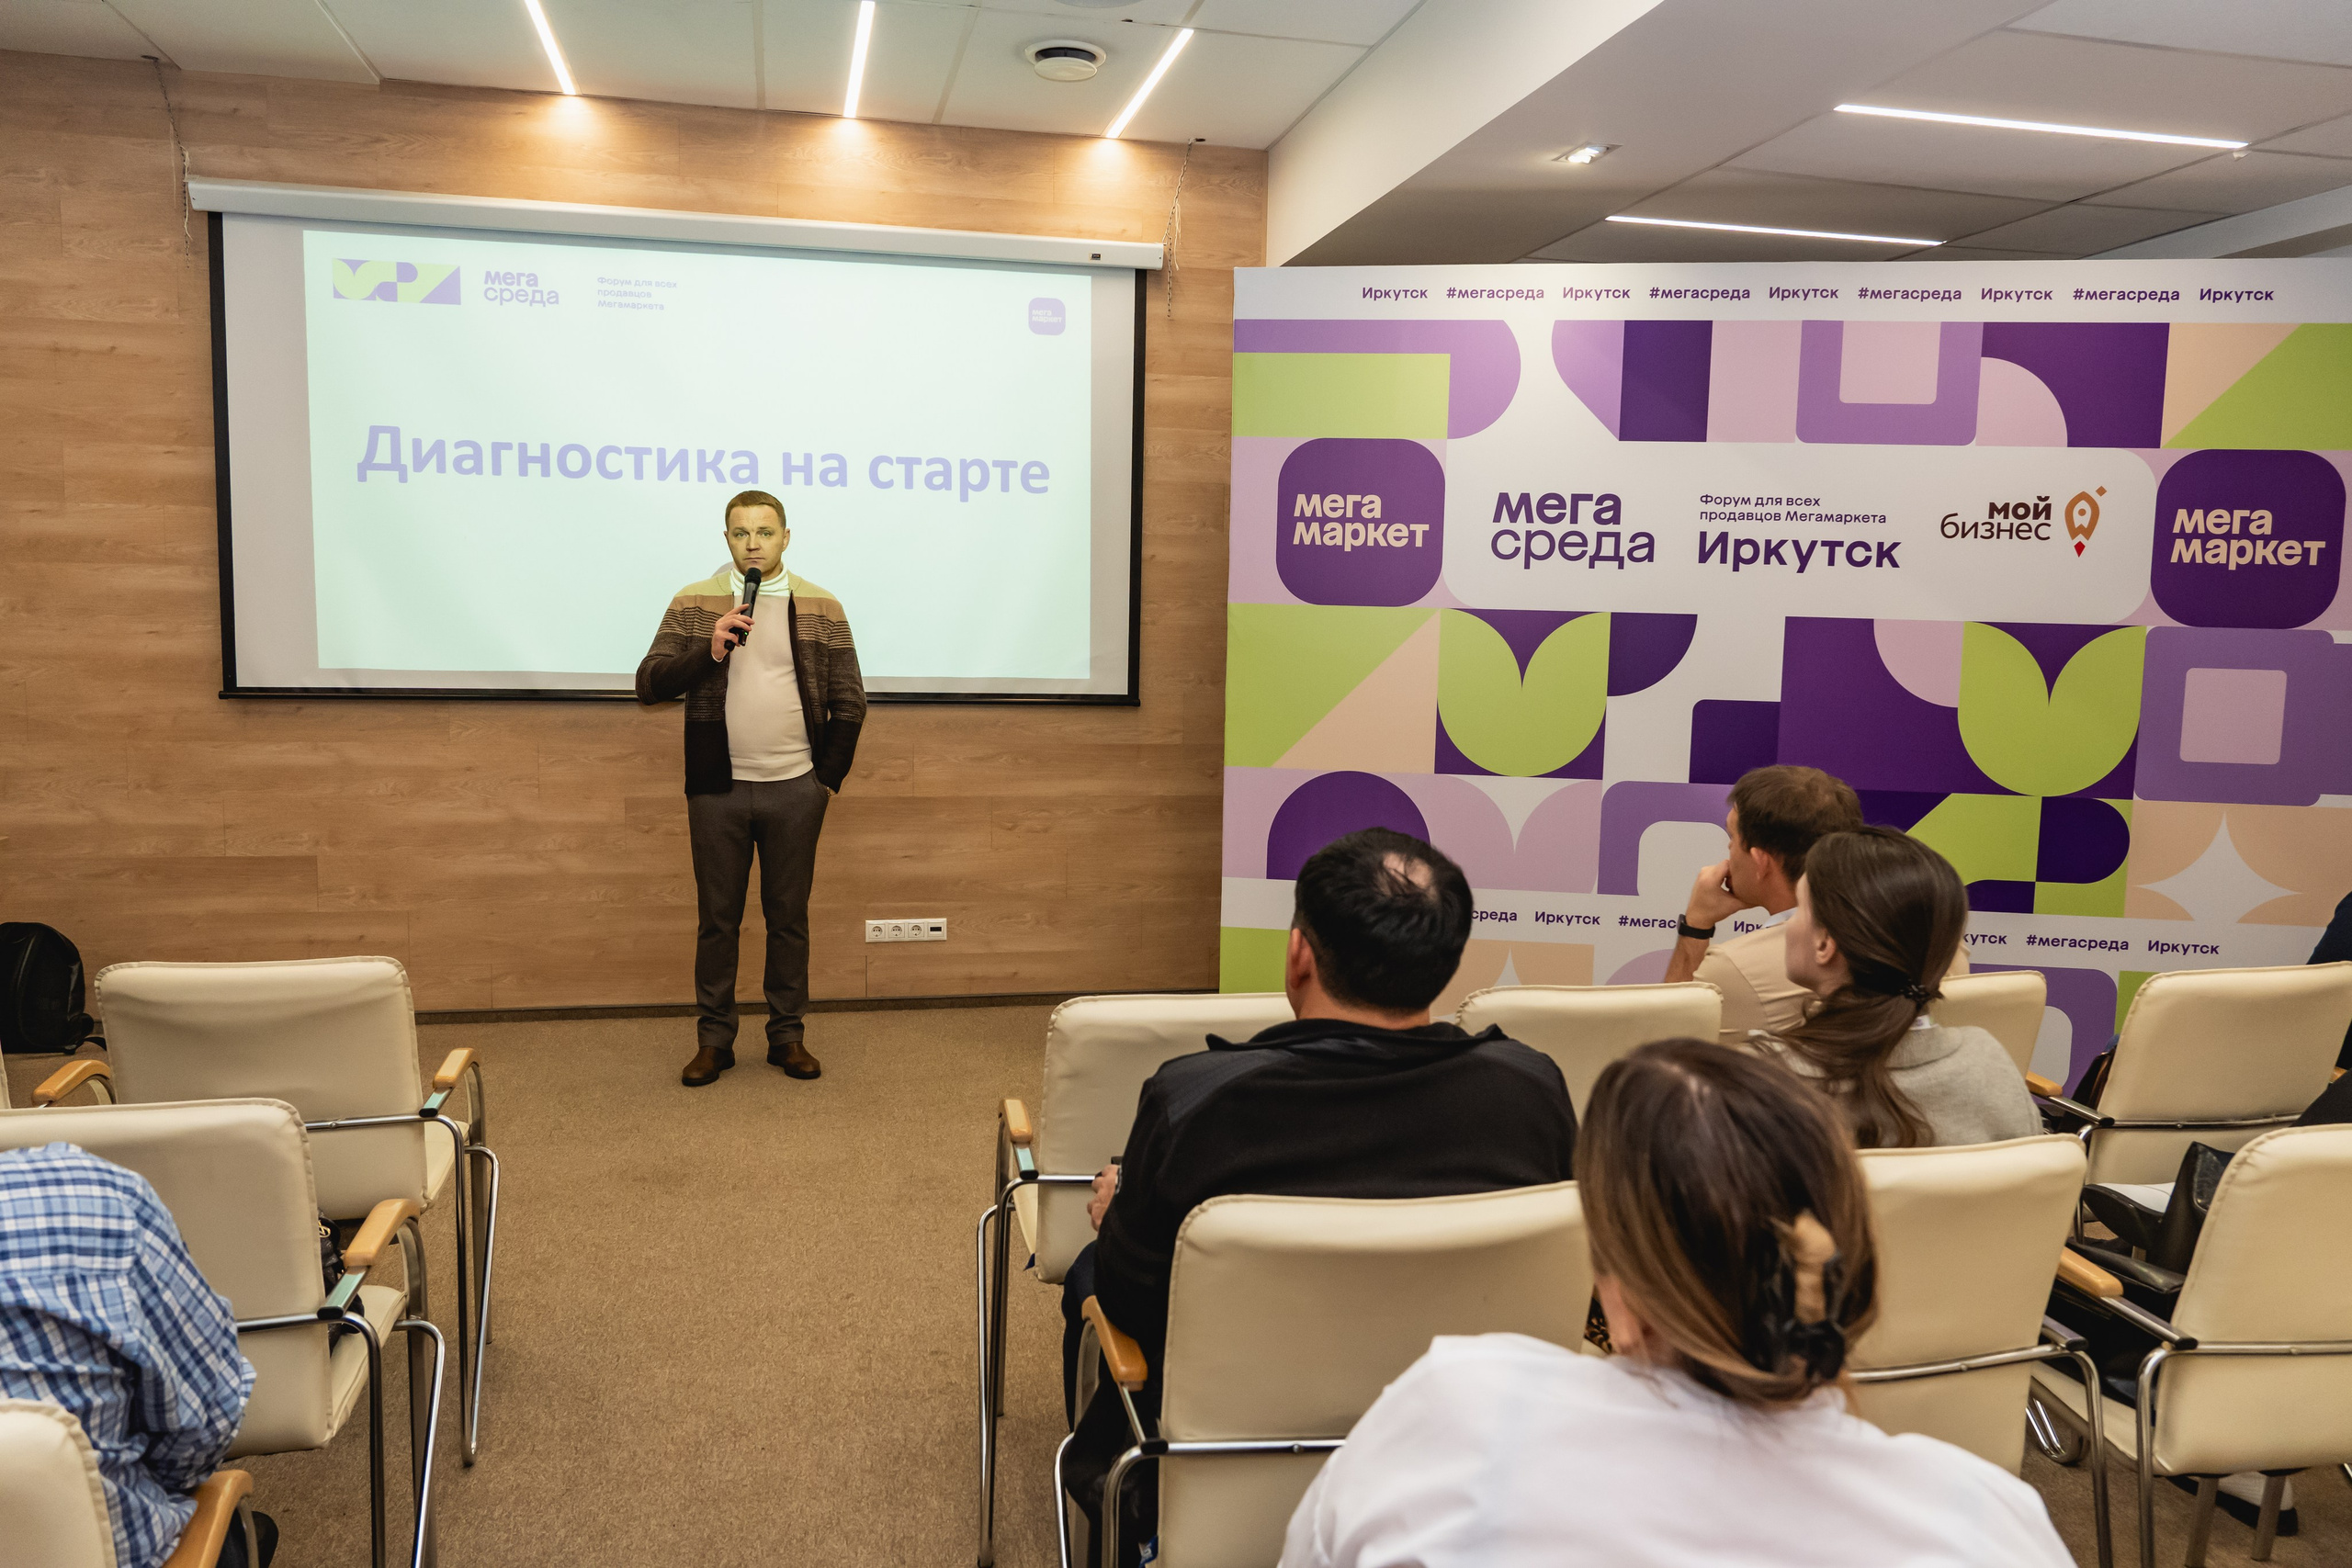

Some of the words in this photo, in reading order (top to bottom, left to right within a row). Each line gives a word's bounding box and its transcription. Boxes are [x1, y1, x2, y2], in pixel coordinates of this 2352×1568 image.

[484, 270, 538, 288] мега
[596, 276, 632, 288] Форум
[633, 279, 653, 288] для
[654, 280, 677, 288] всех
[484, 285, 559, 307] среда
[597, 288, 652, 299] продавцов
[597, 299, 665, 310] Мегамаркета
[1363, 288, 1427, 300] Иркутск
[1446, 288, 1544, 300] #мегасреда
[1564, 288, 1630, 300] Иркутск
[1650, 288, 1749, 301] #мегасреда
[1770, 287, 1838, 300] Иркутск
[1858, 288, 1962, 301] #мегасреда
[1982, 288, 2052, 302] Иркутск
[2073, 288, 2179, 303] #мегасреда
[2200, 288, 2274, 303] Иркутск
[357, 425, 759, 484] Диагностика
[783, 451, 848, 488] на
[869, 456, 1049, 502] старте
[1294, 494, 1381, 518] мега
[1492, 492, 1622, 525] мега
[1701, 494, 1750, 507] Форум
[1754, 497, 1782, 508] для
[1786, 497, 1821, 507] всех
[1988, 496, 2052, 520] мой
[1700, 511, 1781, 524] продавцов
[1785, 511, 1885, 525] Мегамаркета
[1940, 513, 2051, 541] бизнес
[2173, 508, 2272, 536] мега
[1294, 522, 1429, 551] маркет
[1491, 529, 1655, 570] среда
[1699, 531, 1901, 573] Иркутск
[2170, 538, 2325, 570] маркет
[1472, 910, 1517, 922] среда
[1535, 911, 1600, 926] Иркутск
[1619, 916, 1676, 929] #мегас
[2027, 935, 2129, 952] #мегасреда
[2148, 941, 2219, 955] Иркутск
